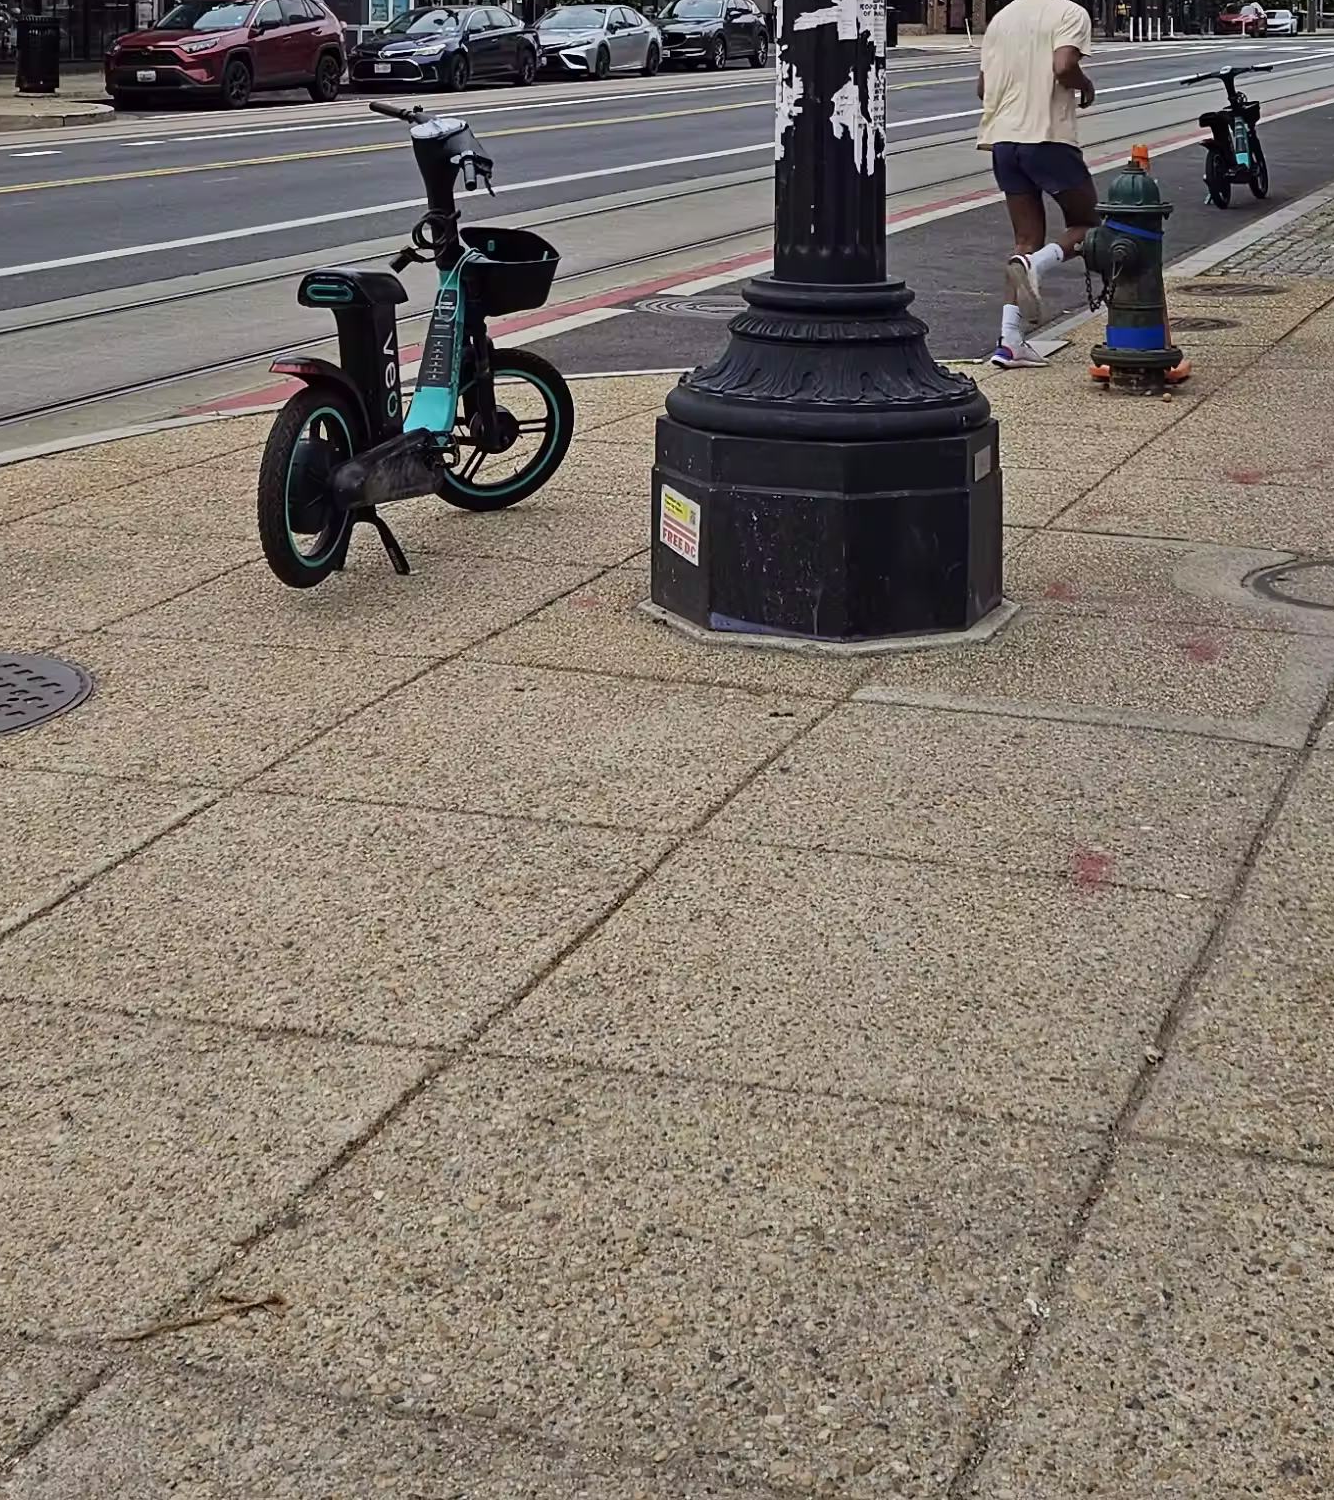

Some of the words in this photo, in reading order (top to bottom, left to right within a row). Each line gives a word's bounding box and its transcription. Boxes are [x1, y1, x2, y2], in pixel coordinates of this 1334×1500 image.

[383, 331, 399, 419] veo
[663, 527, 683, 551] FREE
[684, 541, 696, 558] DC
